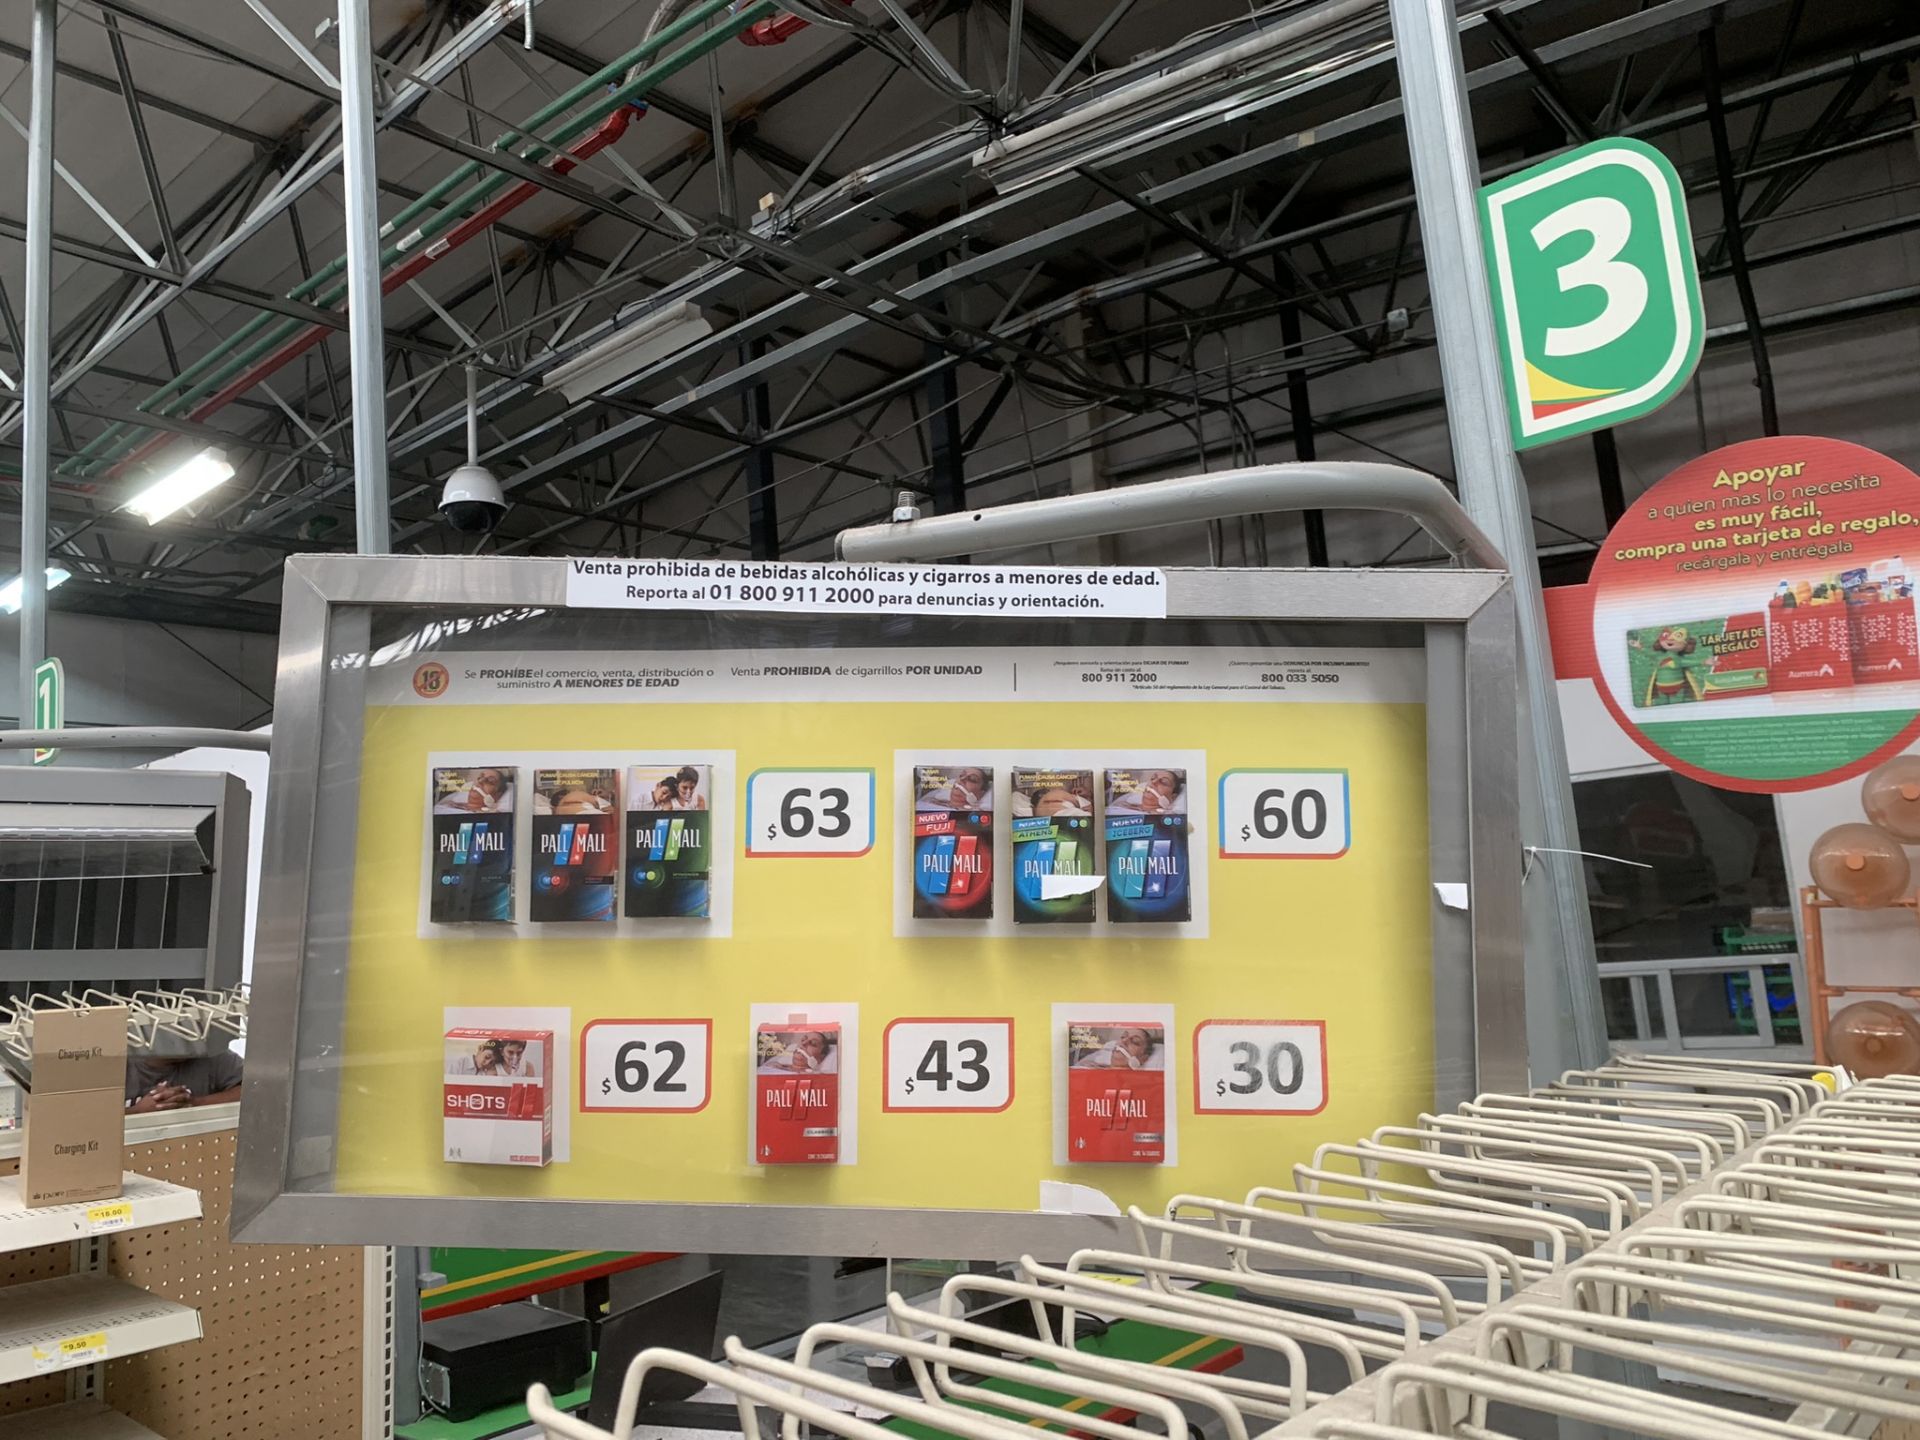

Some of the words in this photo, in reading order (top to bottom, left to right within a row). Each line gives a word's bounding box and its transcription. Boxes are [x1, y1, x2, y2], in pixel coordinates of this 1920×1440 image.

[1530, 196, 1648, 356] 3
[1713, 462, 1805, 490] Apoyar
[1648, 508, 1658, 519] a
[1663, 500, 1716, 519] quien
[1722, 493, 1761, 508] mas
[1767, 487, 1785, 502] lo
[1792, 474, 1880, 498] necesita
[1694, 519, 1716, 531] es
[1722, 511, 1764, 528] muy
[1770, 500, 1822, 521] fácil,
[1615, 542, 1686, 560] compra
[1692, 537, 1727, 551] una
[1733, 526, 1801, 547] tarjeta
[1807, 520, 1835, 536] de
[1841, 510, 1919, 533] regalo,
[1676, 552, 1750, 571] recárgala
[1756, 552, 1766, 566] y
[1770, 540, 1853, 560] entrégala
[574, 560, 622, 575] Venta
[627, 562, 710, 578] prohibida
[715, 564, 735, 578] de
[740, 565, 807, 580] bebidas
[811, 567, 905, 583] alcohólicas
[909, 571, 919, 585] y
[923, 569, 989, 585] cigarros
[995, 573, 1004, 584] a
[1009, 572, 1082, 585] menores
[1087, 570, 1108, 585] de
[1112, 571, 1160, 586] edad.
[626, 585, 688, 601] Reporta
[692, 586, 706, 600] al
[710, 584, 732, 600] 01
[740, 585, 777, 601] 800
[783, 586, 817, 602] 911
[825, 587, 874, 603] 2000
[878, 594, 912, 607] para
[917, 592, 995, 607] denuncias
[999, 597, 1007, 610] y
[1011, 592, 1104, 609] orientación.
[1701, 629, 1749, 645] TARJETA
[1750, 627, 1764, 638] DE
[1714, 639, 1759, 653] REGALO
[465, 670, 476, 679] Se
[533, 669, 544, 678] el
[545, 669, 600, 680] comercio,
[602, 669, 636, 679] venta,
[638, 668, 703, 678] distribución
[731, 667, 760, 677] Venta
[763, 666, 831, 676] PROHIBIDA
[835, 666, 849, 676] de
[851, 666, 903, 677] cigarrillos
[906, 665, 930, 675] POR
[933, 665, 982, 675] UNIDAD
[1081, 673, 1102, 682] 800
[1106, 673, 1126, 682] 911
[1129, 673, 1157, 682] 2000
[1261, 673, 1283, 683] 800
[1286, 674, 1307, 683] 033
[1310, 674, 1340, 683] 5050
[497, 679, 550, 688] suministro
[553, 679, 563, 688] A
[565, 679, 623, 688] MENORES
[626, 678, 642, 688] DE
[645, 678, 679, 687] EDAD
[39, 677, 51, 730] 1
[767, 787, 851, 841] $63
[919, 813, 947, 823] NUEVO
[1112, 818, 1143, 827] NUEVO
[1241, 788, 1327, 842] $60
[926, 823, 951, 831] FUJI
[1018, 830, 1053, 838] ATHENS
[1112, 826, 1151, 837] ICEBERG
[440, 834, 468, 852] PALL
[475, 832, 505, 851] MALL
[541, 834, 568, 853] PALL
[577, 833, 606, 852] MALL
[636, 829, 663, 848] PALL
[671, 829, 701, 848] MALL
[923, 854, 951, 873] PALL
[953, 855, 983, 873] MALL
[1024, 860, 1049, 878] PALL
[1053, 859, 1082, 876] MALL
[1118, 856, 1146, 874] PALL
[1148, 856, 1178, 874] MALL
[58, 1048, 90, 1060] Charging
[92, 1047, 103, 1057] Kit
[601, 1040, 687, 1095] $62
[904, 1039, 991, 1095] $43
[1216, 1041, 1304, 1097] $30
[447, 1093, 505, 1110] SHOTS
[766, 1089, 792, 1107] PALL
[800, 1089, 828, 1107] MALL
[1086, 1098, 1112, 1117] PALL
[1119, 1099, 1148, 1118] MALL
[54, 1143, 87, 1155] Charging
[88, 1141, 98, 1151] Kit
